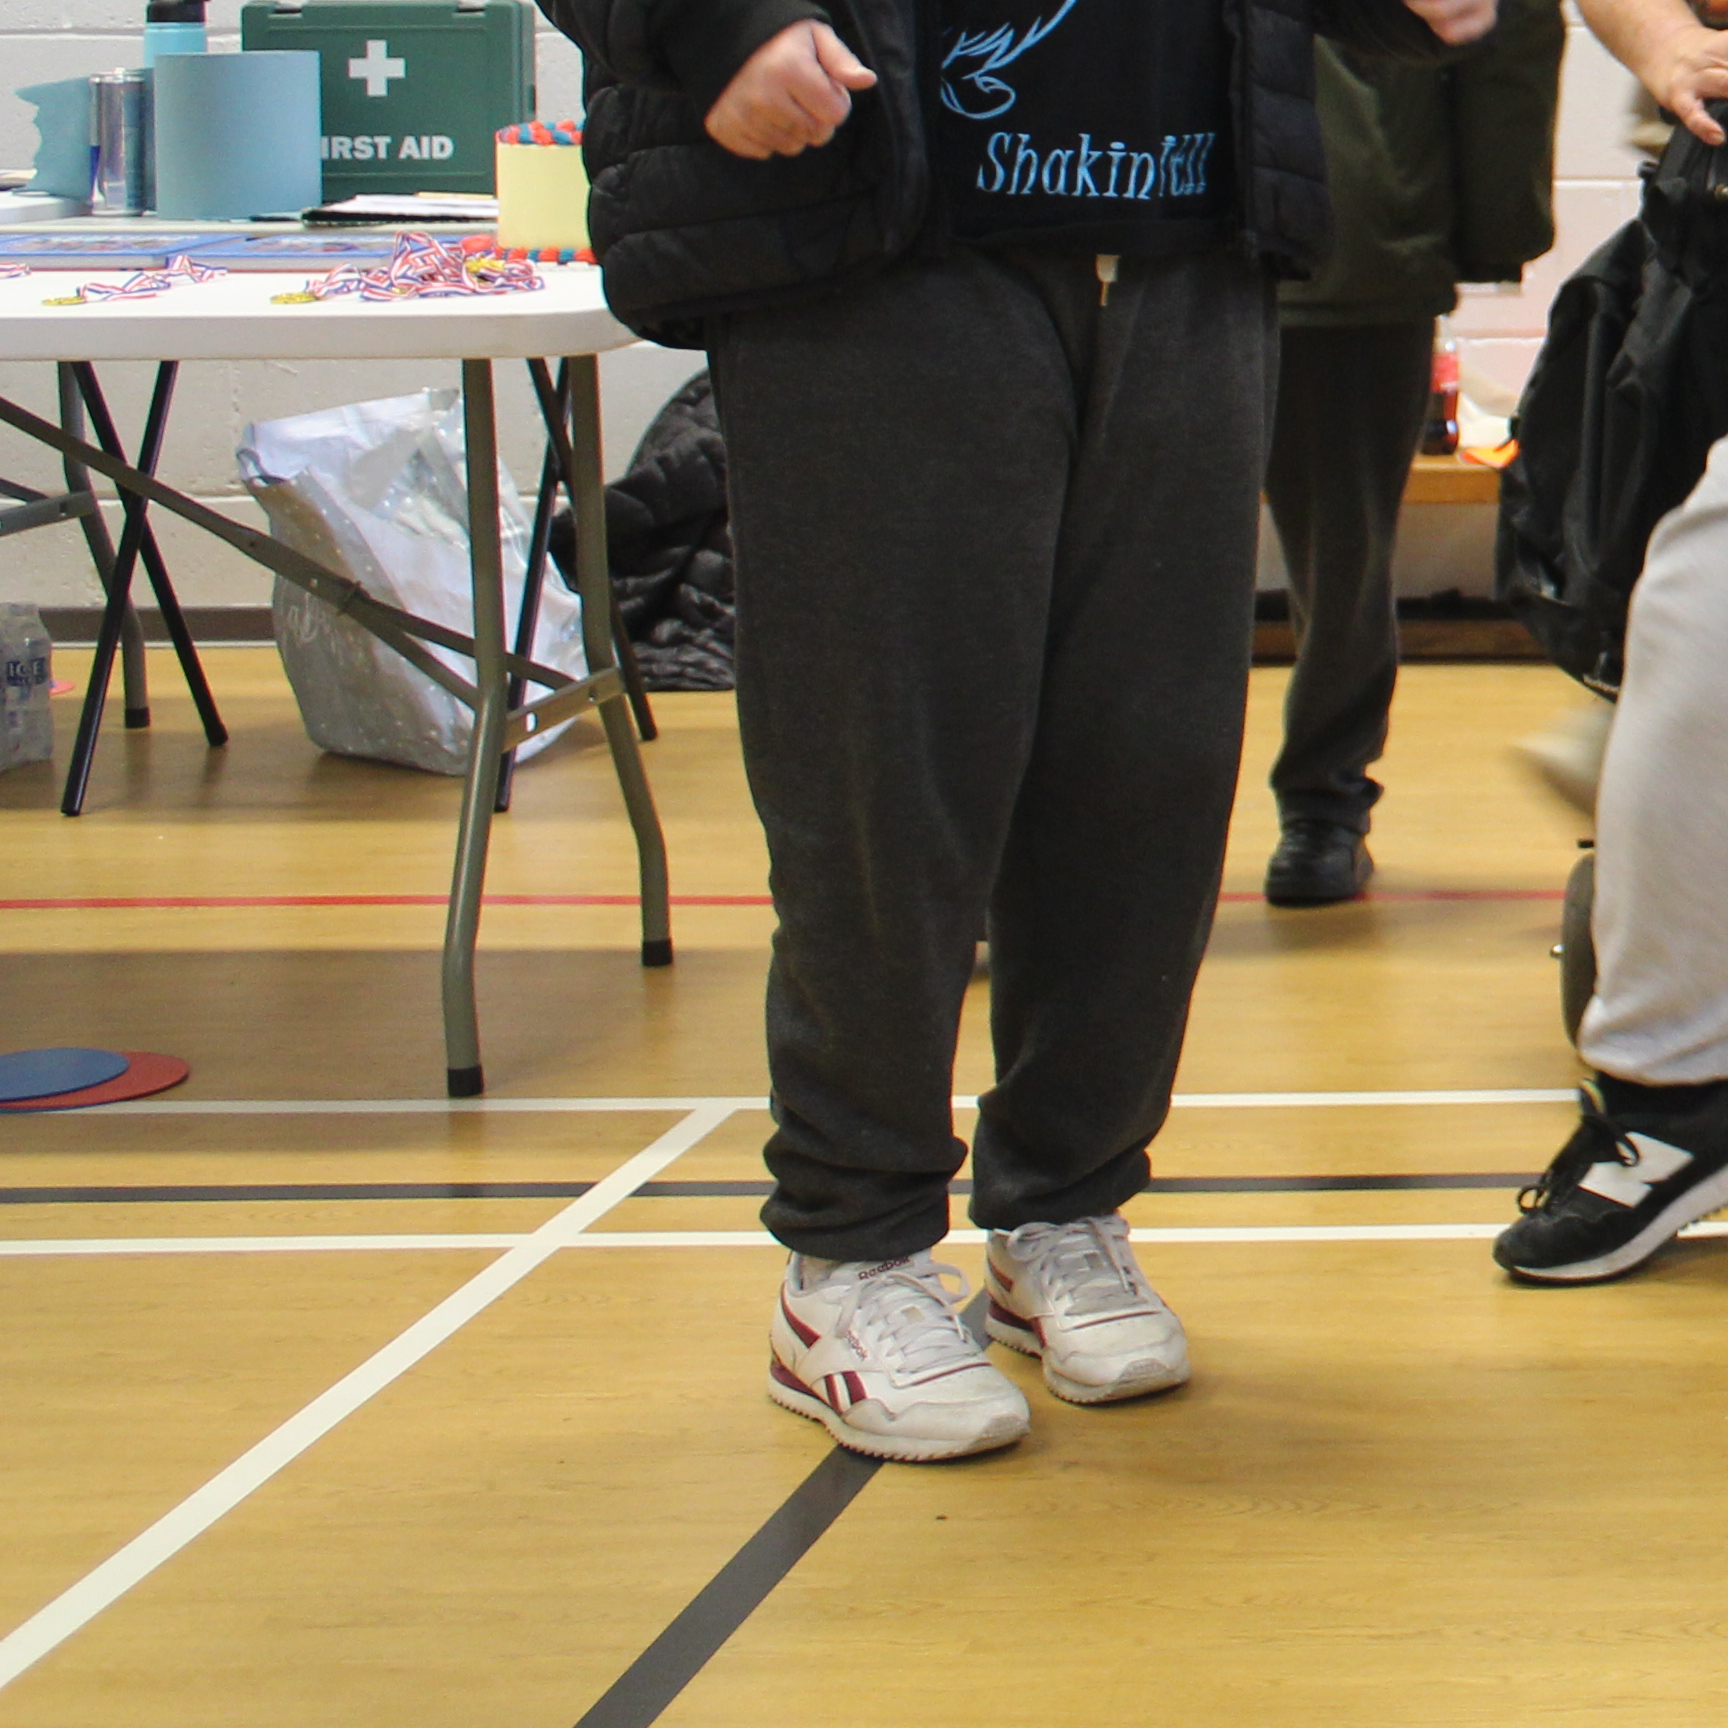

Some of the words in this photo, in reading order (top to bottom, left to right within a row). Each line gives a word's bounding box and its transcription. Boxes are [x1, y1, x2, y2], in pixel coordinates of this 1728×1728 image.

[320, 135, 392, 160] IRST
[398, 135, 454, 160] AID
[976, 131, 1156, 200] Shakin
